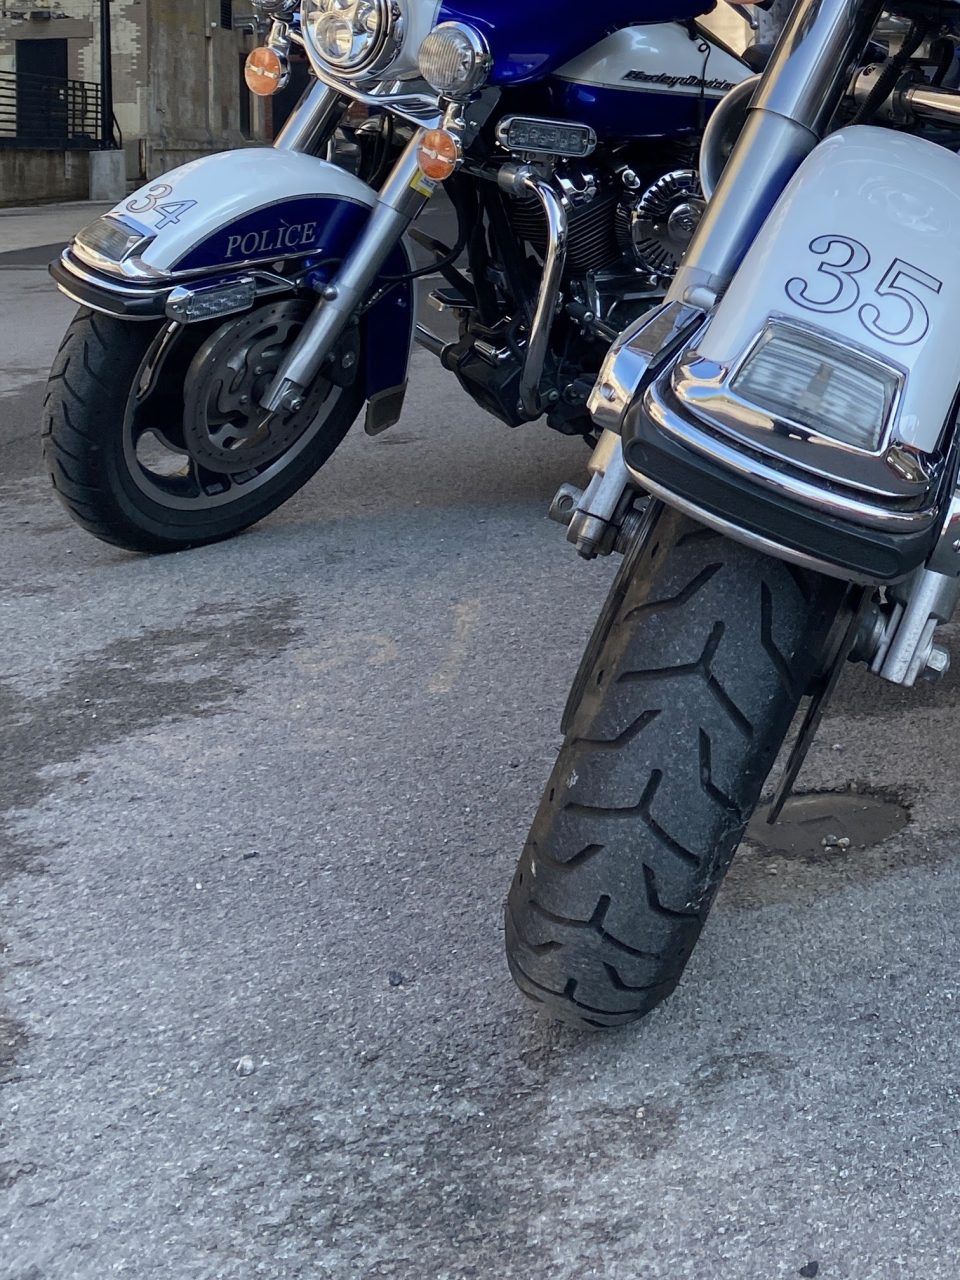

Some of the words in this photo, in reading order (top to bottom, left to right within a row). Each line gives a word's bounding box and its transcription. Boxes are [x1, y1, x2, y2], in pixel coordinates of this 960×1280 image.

[126, 183, 198, 229] 34
[224, 221, 317, 258] POLICE
[784, 234, 944, 346] 35
